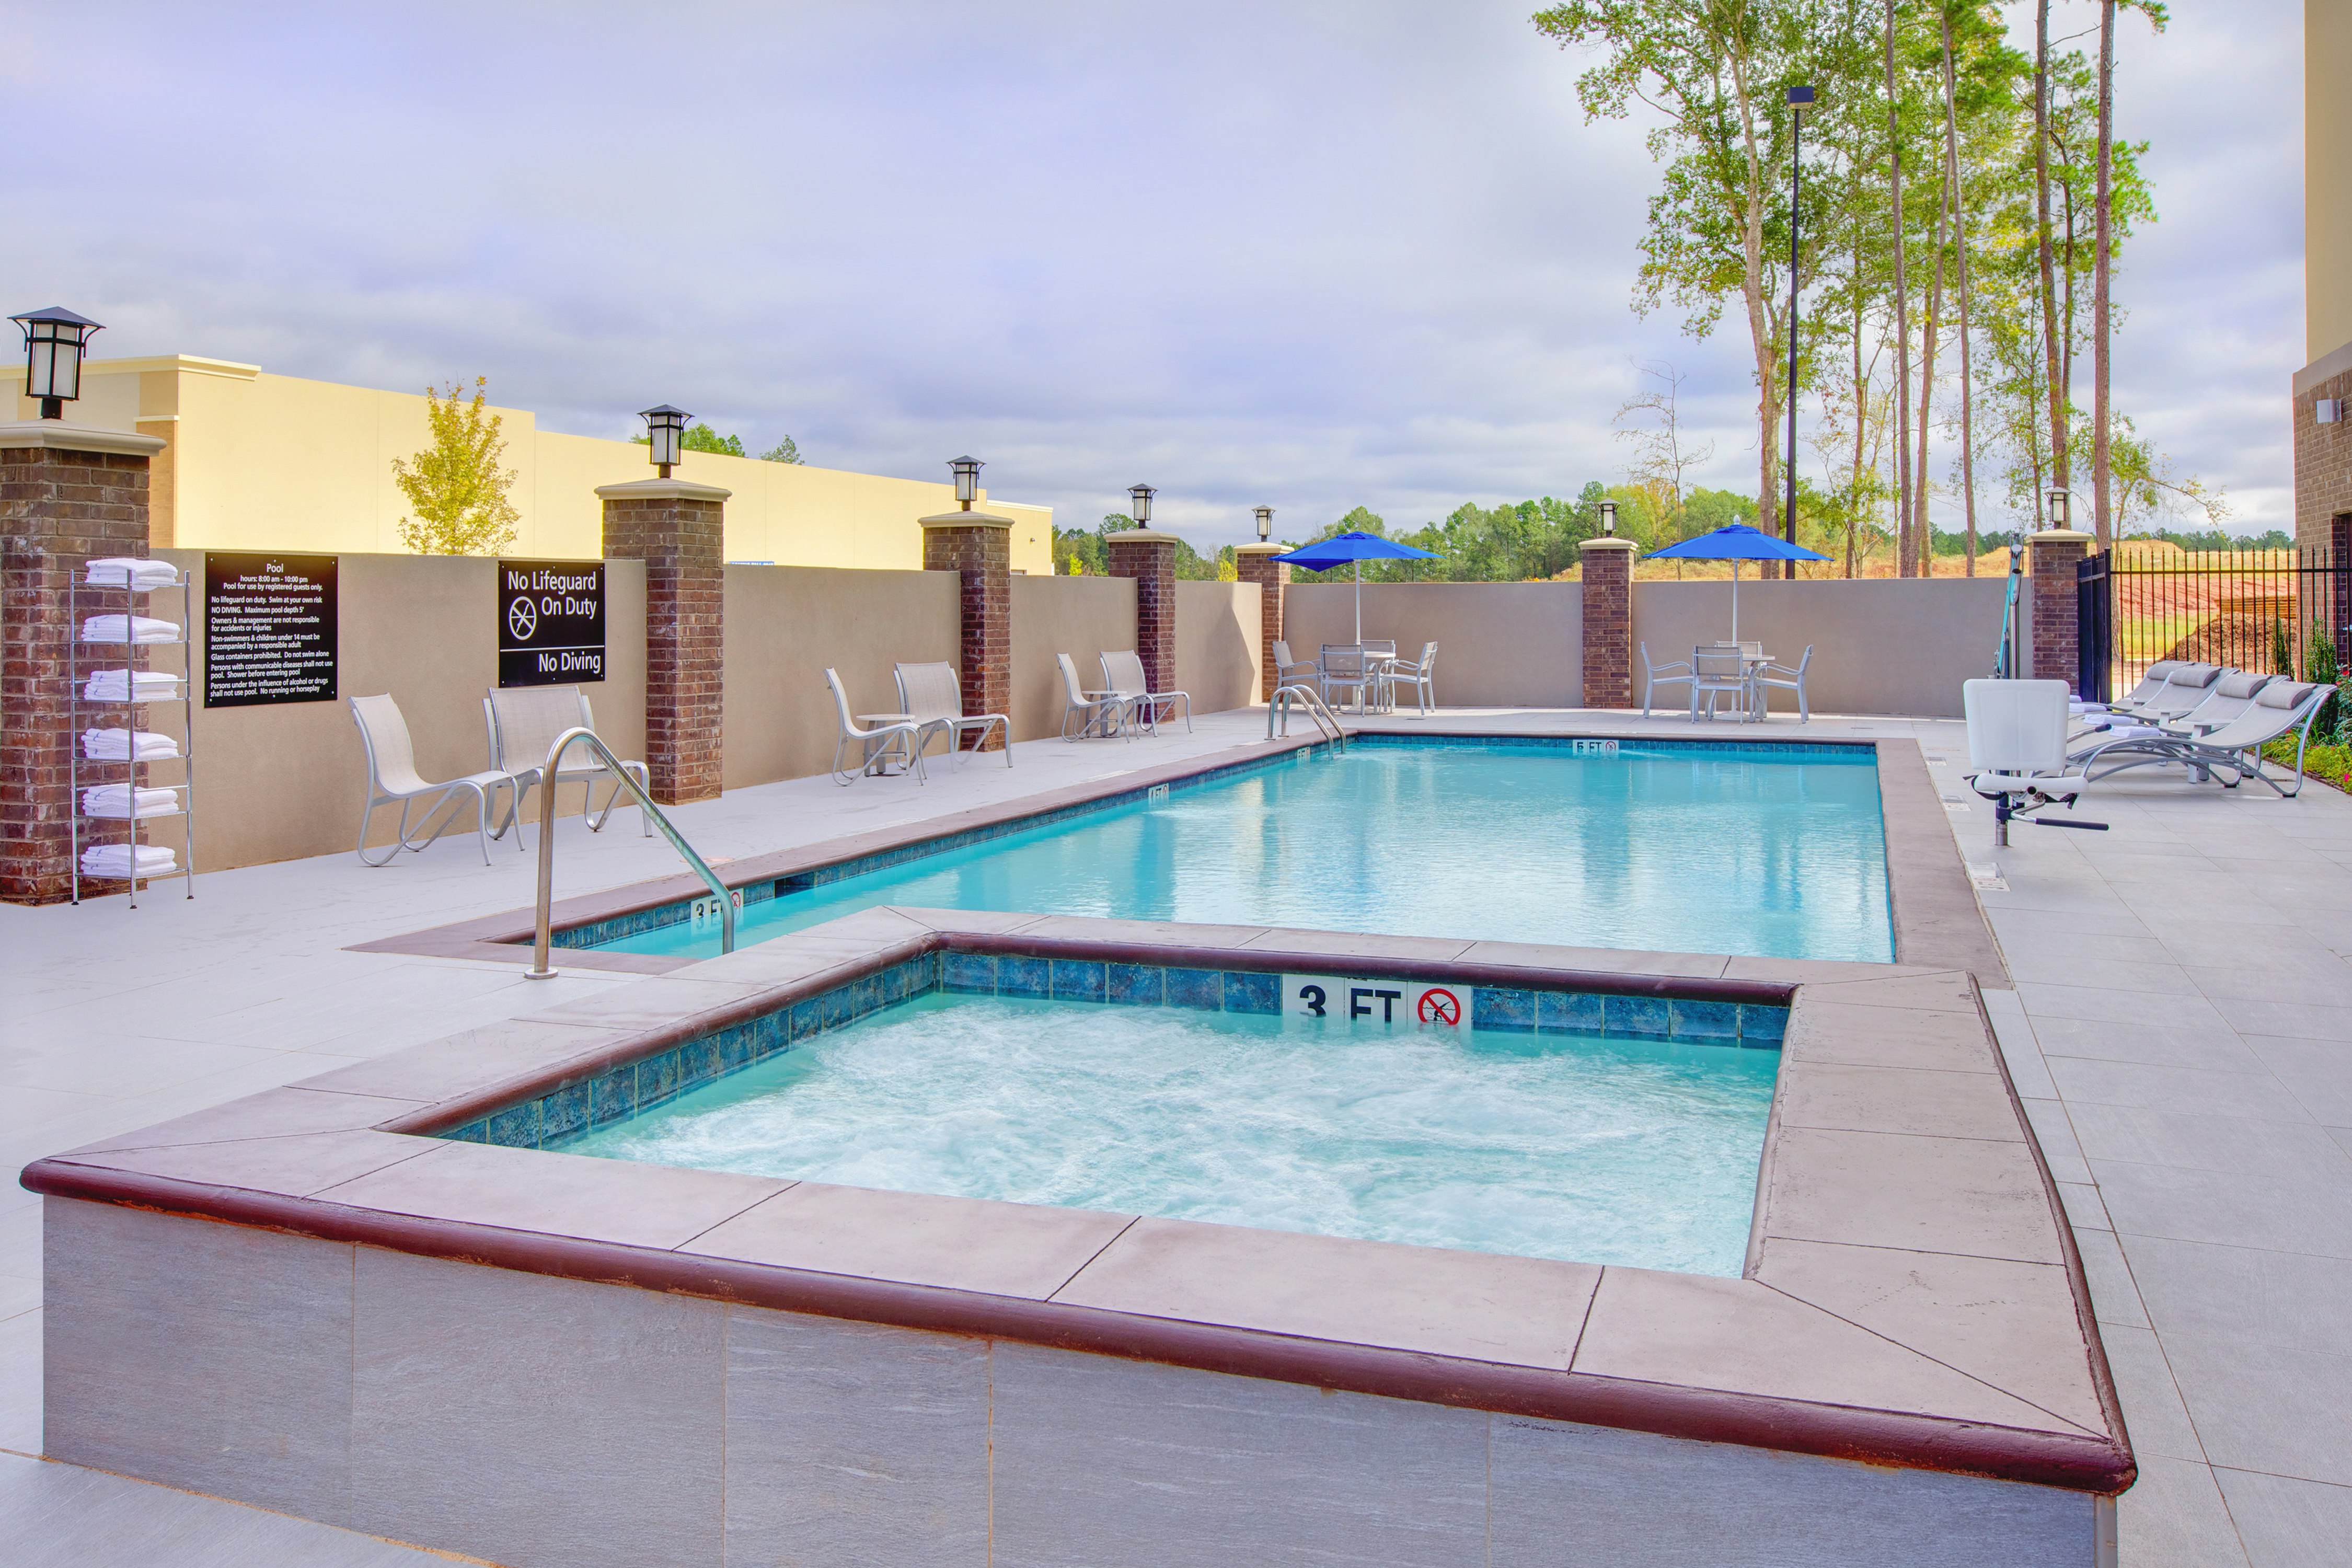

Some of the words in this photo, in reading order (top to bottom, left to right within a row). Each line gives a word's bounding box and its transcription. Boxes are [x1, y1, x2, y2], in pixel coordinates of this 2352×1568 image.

[266, 563, 283, 573] Pool
[508, 571, 528, 590] No
[533, 570, 596, 595] Lifeguard
[541, 596, 561, 615] On
[566, 597, 596, 619] Duty
[238, 617, 272, 625] management
[253, 652, 282, 660] prohibited.
[539, 653, 557, 672] No
[561, 651, 600, 673] Diving
[211, 672, 224, 680] pool.
[1589, 742, 1601, 752] FT
[696, 903, 704, 918] 3
[1299, 985, 1327, 1017] 3
[1351, 988, 1401, 1022] FT
